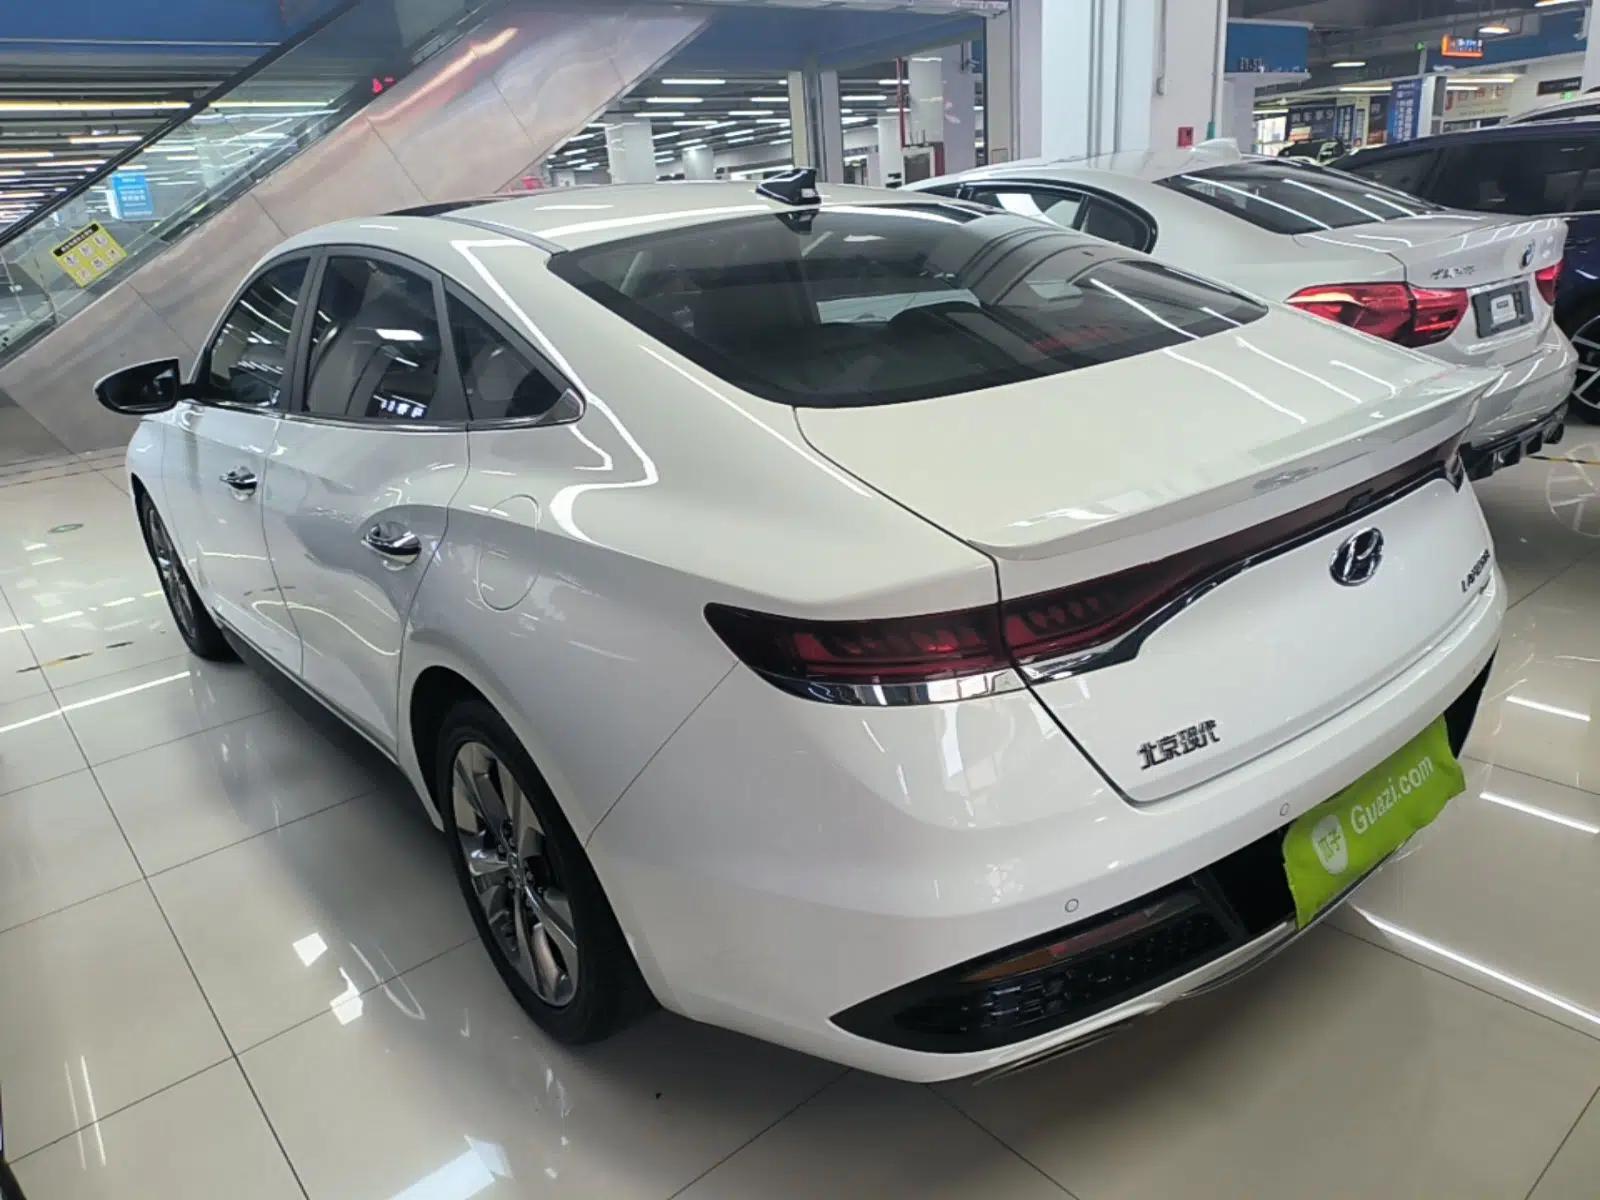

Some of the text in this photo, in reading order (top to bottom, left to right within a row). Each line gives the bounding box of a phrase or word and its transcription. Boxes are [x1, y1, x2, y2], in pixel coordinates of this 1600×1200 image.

[1137, 719, 1221, 771] 北京现代
[1350, 755, 1435, 835] Guazi.com
